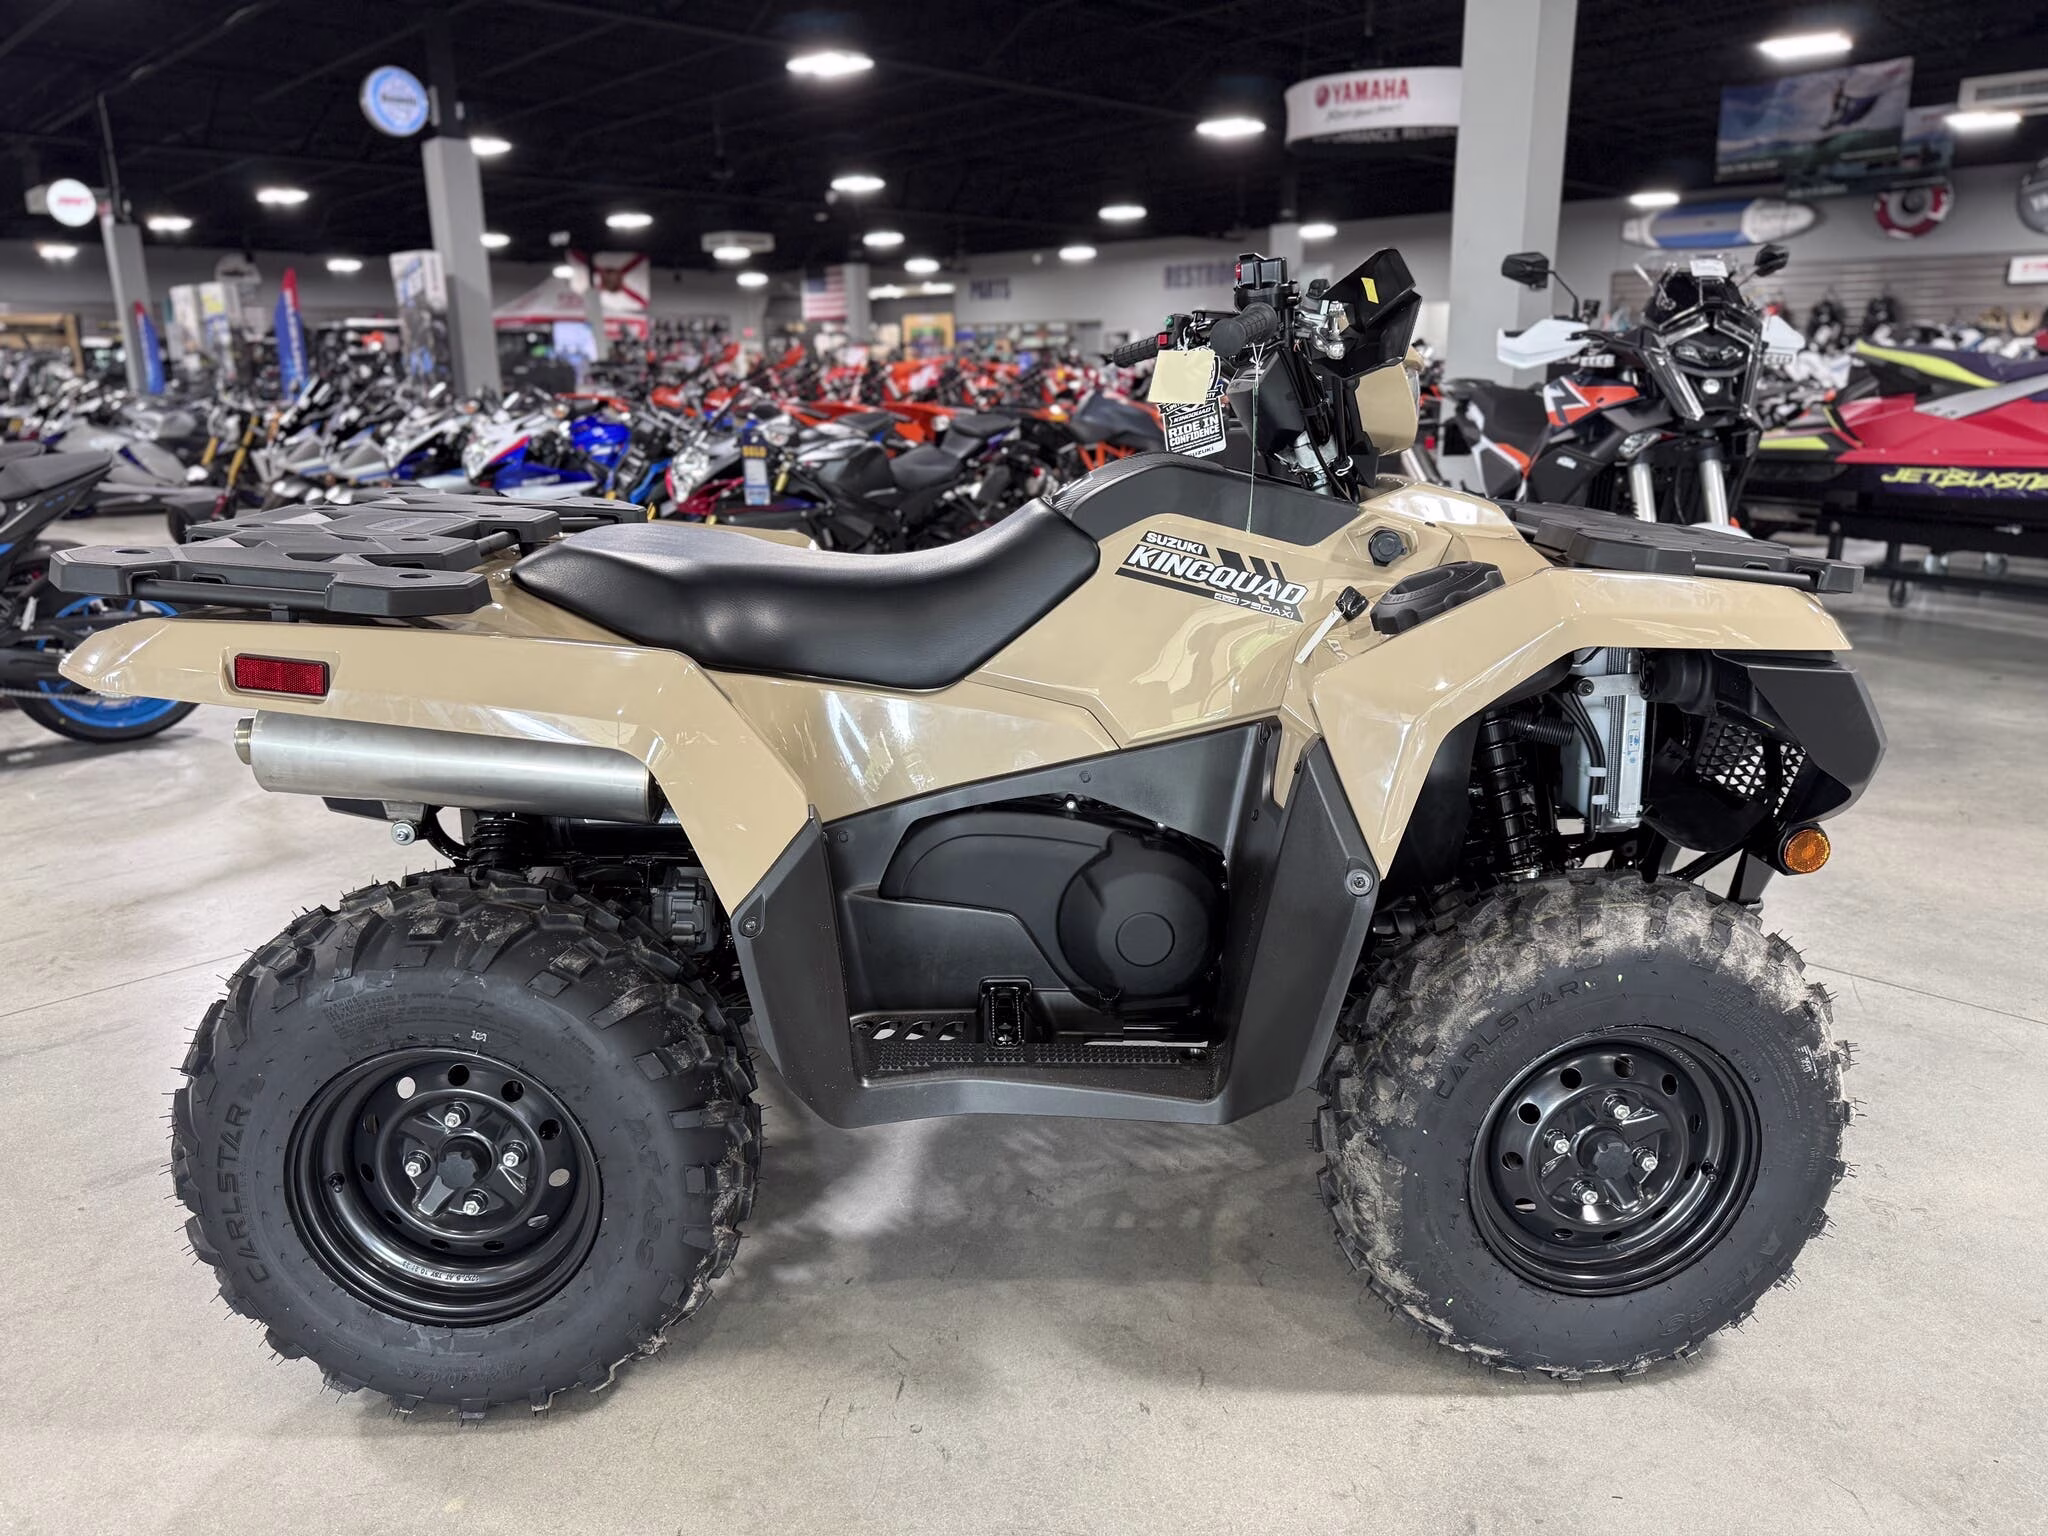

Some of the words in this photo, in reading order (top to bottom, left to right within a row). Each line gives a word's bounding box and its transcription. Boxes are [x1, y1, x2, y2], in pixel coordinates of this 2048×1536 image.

[1331, 77, 1410, 105] YAMAHA
[1165, 263, 1237, 290] RESTRO
[1168, 420, 1201, 439] RIDE
[1203, 414, 1219, 429] IN
[1169, 424, 1221, 447] CONFIDENCE
[1881, 466, 2048, 491] JETBLASTE
[1145, 532, 1204, 554] SUZUKI
[1128, 545, 1308, 605] KINGQUAD
[1432, 979, 1580, 1100] CARLSTAR
[217, 1101, 271, 1284] CARLSTAR
